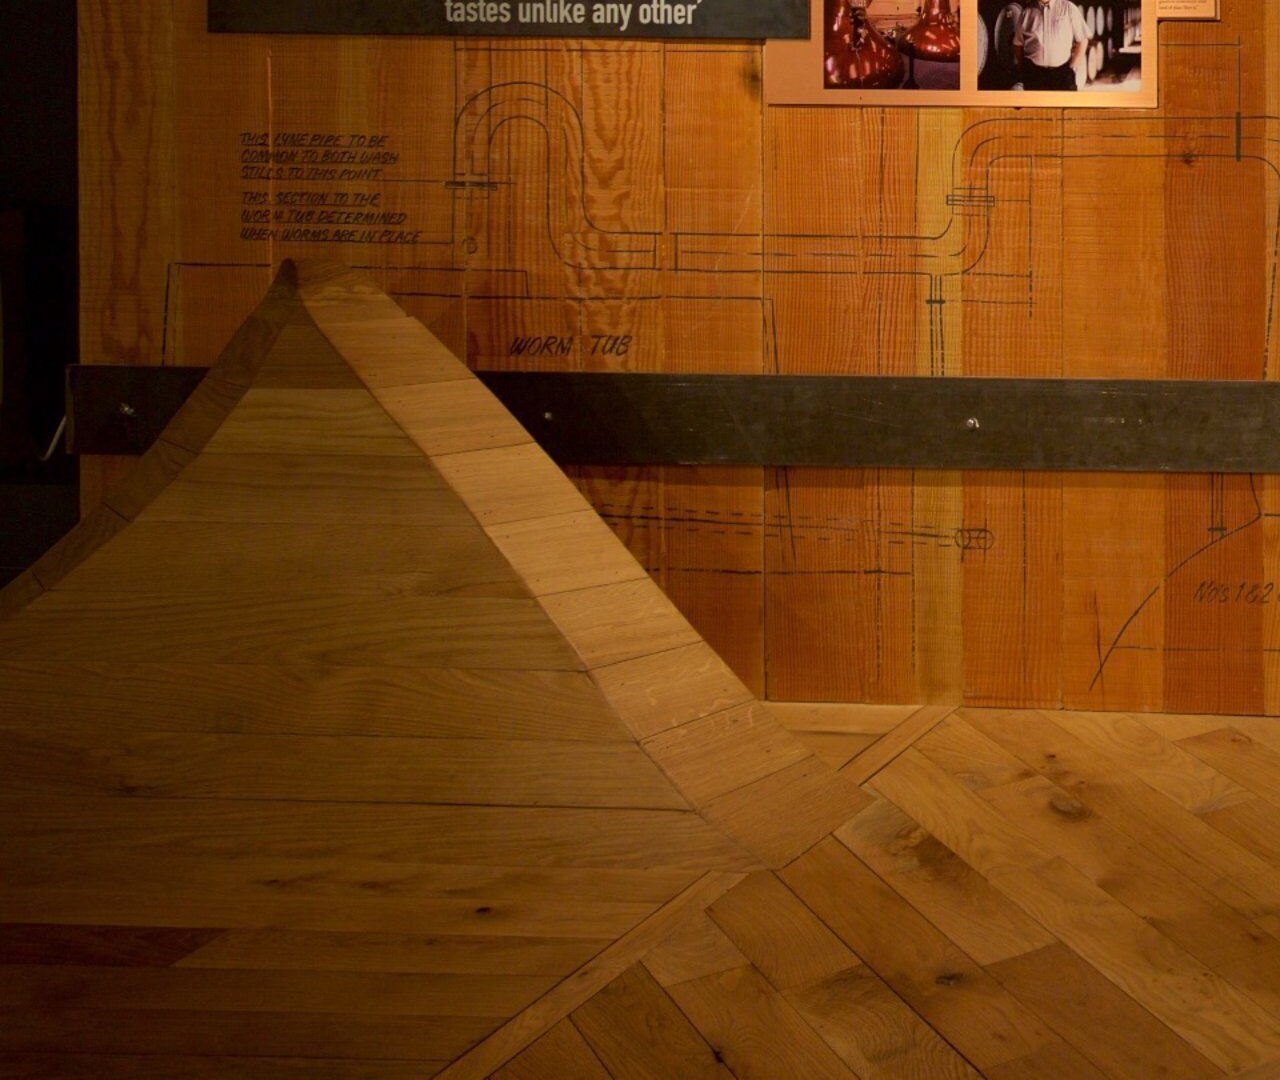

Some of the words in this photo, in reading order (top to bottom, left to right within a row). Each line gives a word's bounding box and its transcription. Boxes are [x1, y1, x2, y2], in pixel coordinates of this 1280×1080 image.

[592, 1, 632, 31] any
[510, 335, 574, 357] WORM
[590, 333, 633, 356] TUB
